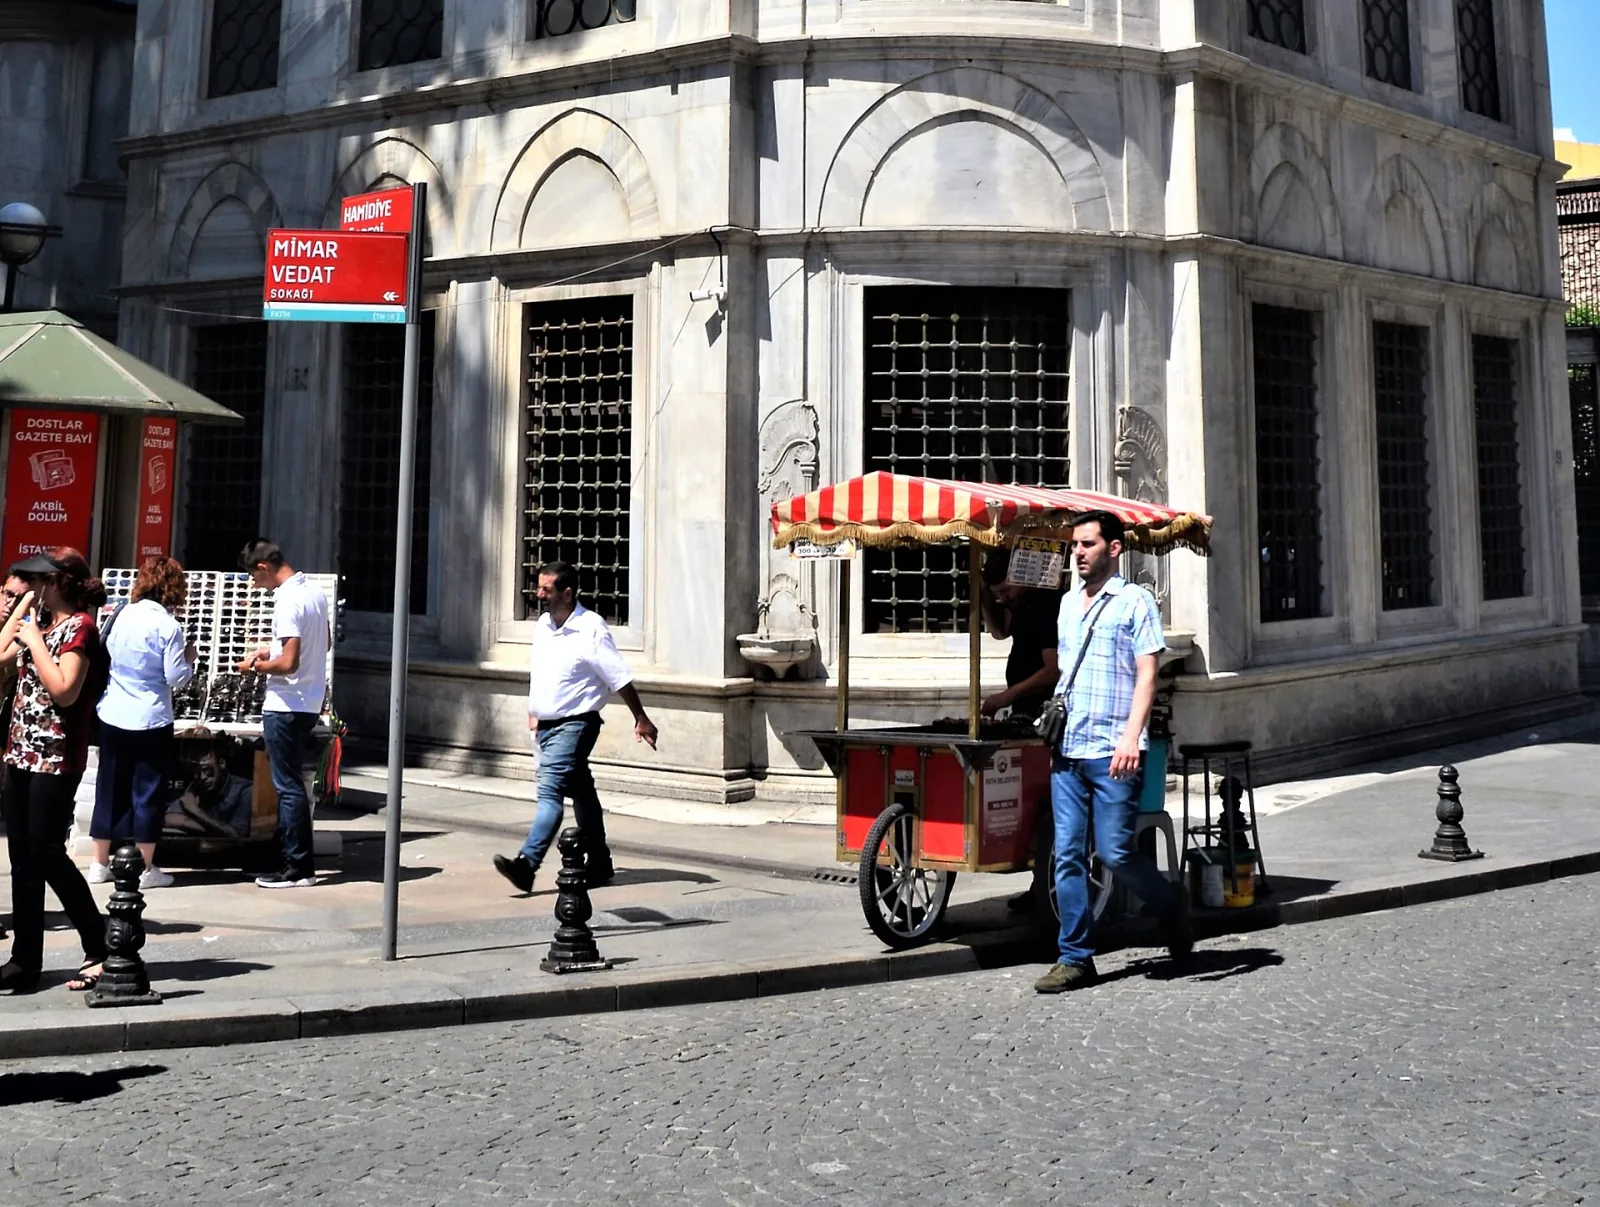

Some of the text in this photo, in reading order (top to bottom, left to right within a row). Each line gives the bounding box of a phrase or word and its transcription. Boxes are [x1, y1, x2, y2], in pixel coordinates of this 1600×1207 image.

[343, 199, 392, 224] HAMİDİYE
[274, 237, 338, 258] MİMAR
[272, 265, 335, 284] VEDAT
[270, 288, 314, 300] SOKAĞI
[27, 418, 83, 430] DOSTLAR
[148, 425, 170, 436] DOSTLAR
[16, 432, 92, 444] GAZETE BAYİ
[143, 439, 162, 449] GAZETE
[32, 500, 65, 511] AKBİL
[28, 513, 68, 522] DOLUM
[146, 515, 162, 524] DOLUM
